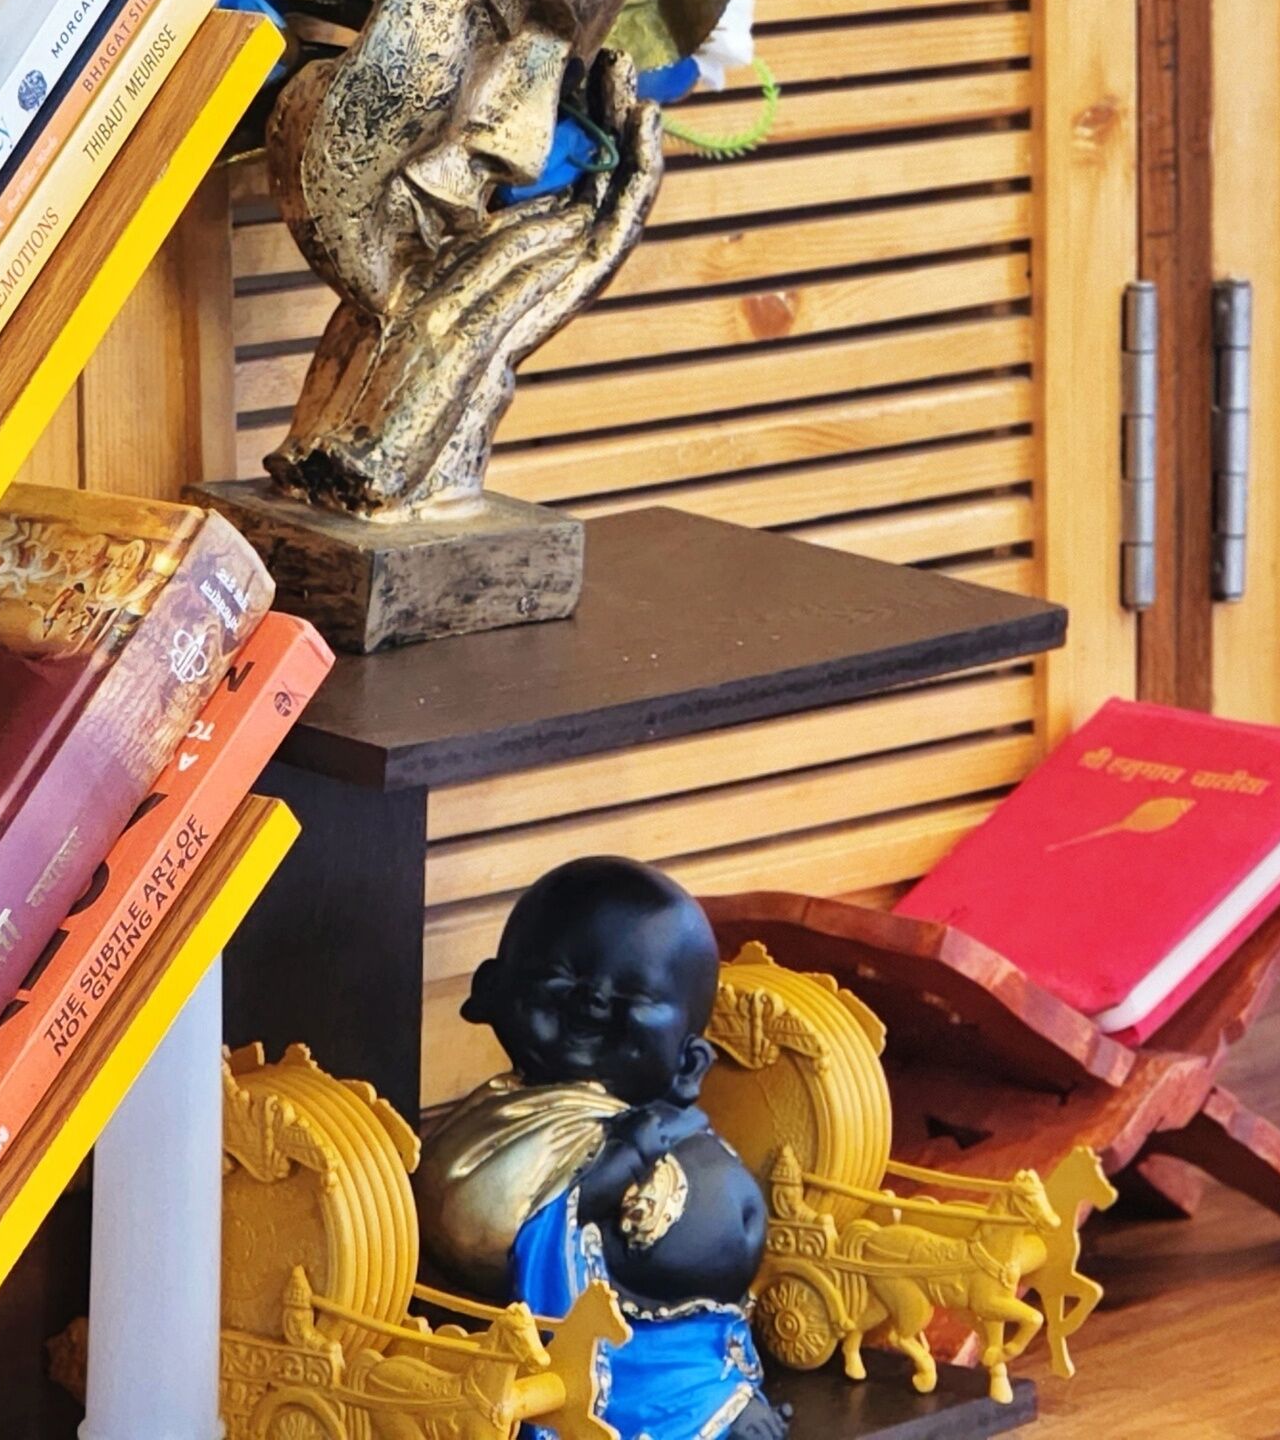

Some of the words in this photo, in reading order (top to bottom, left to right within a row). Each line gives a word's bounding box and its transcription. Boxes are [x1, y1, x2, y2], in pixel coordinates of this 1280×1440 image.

[82, 21, 133, 93] BHAGAT
[82, 95, 128, 162] THIBAUT
[125, 24, 177, 101] MEURISSE
[178, 752, 199, 771] A
[1190, 769, 1271, 796] चालीसा
[44, 993, 80, 1043] THE
[80, 901, 143, 994] SUBTLE
[143, 849, 174, 901] ART
[176, 814, 199, 849] OF
[53, 1001, 88, 1057] NOT
[91, 914, 152, 1001] GIVING
[155, 893, 169, 911] A
